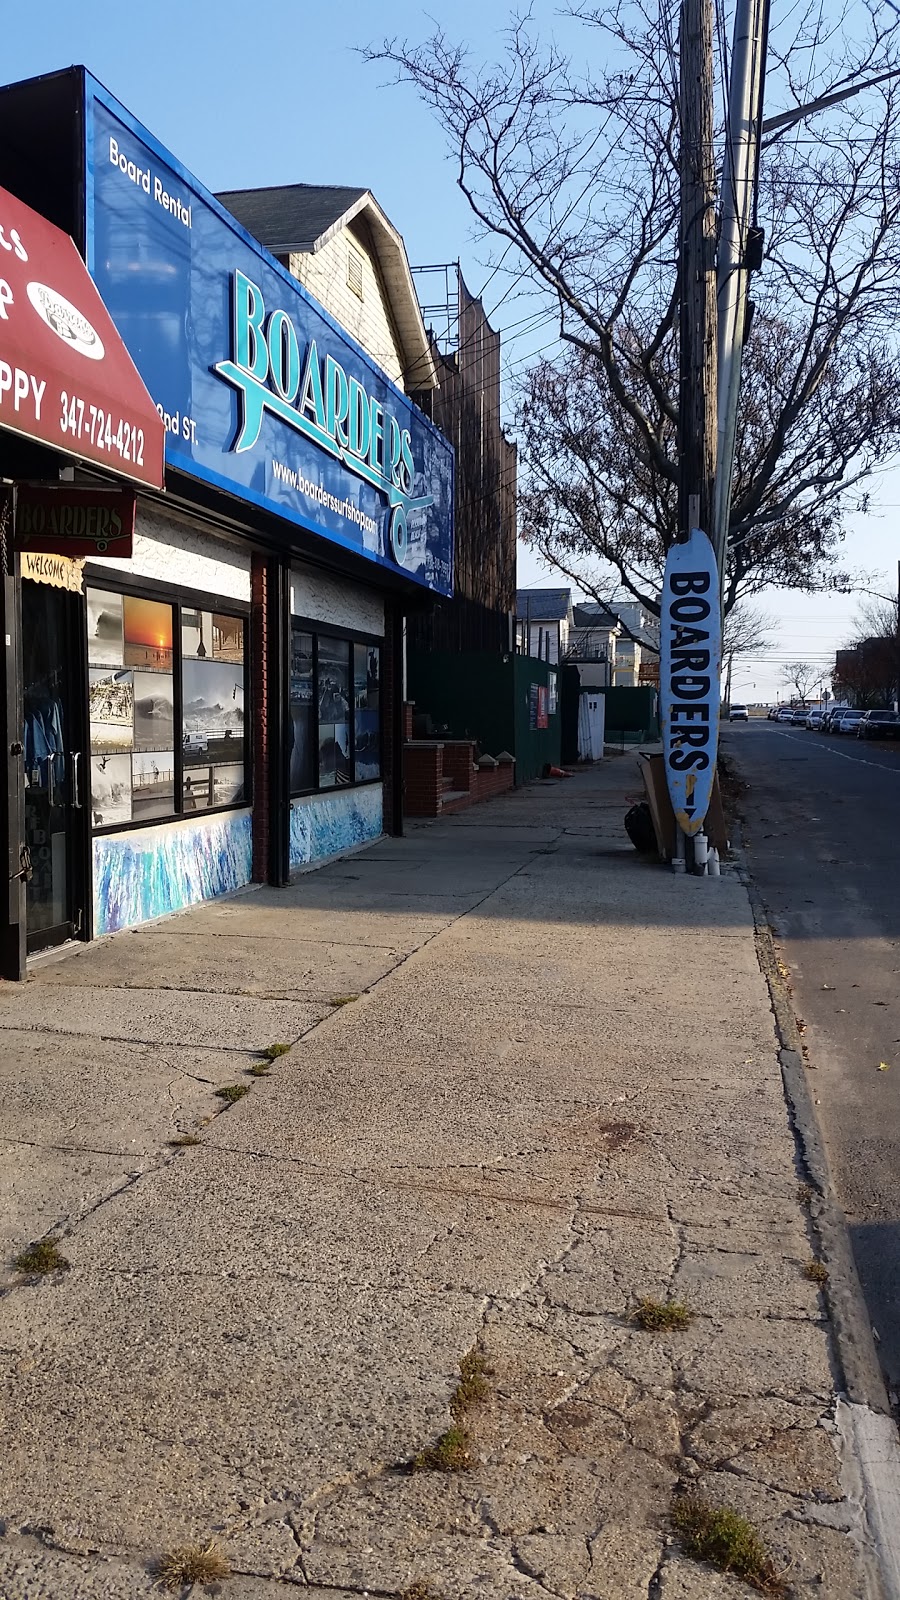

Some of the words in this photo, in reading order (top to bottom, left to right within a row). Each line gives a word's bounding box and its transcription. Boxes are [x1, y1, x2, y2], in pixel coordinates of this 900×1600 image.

[109, 136, 151, 194] Board
[154, 176, 192, 229] Rental
[234, 268, 415, 496] BOARDERS
[60, 391, 144, 466] 347-724-4212
[20, 504, 122, 537] BOARDERS
[272, 460, 377, 535] www.boarderssurfshop.com
[26, 554, 65, 581] WELCOME
[669, 571, 711, 772] BOARDERS
